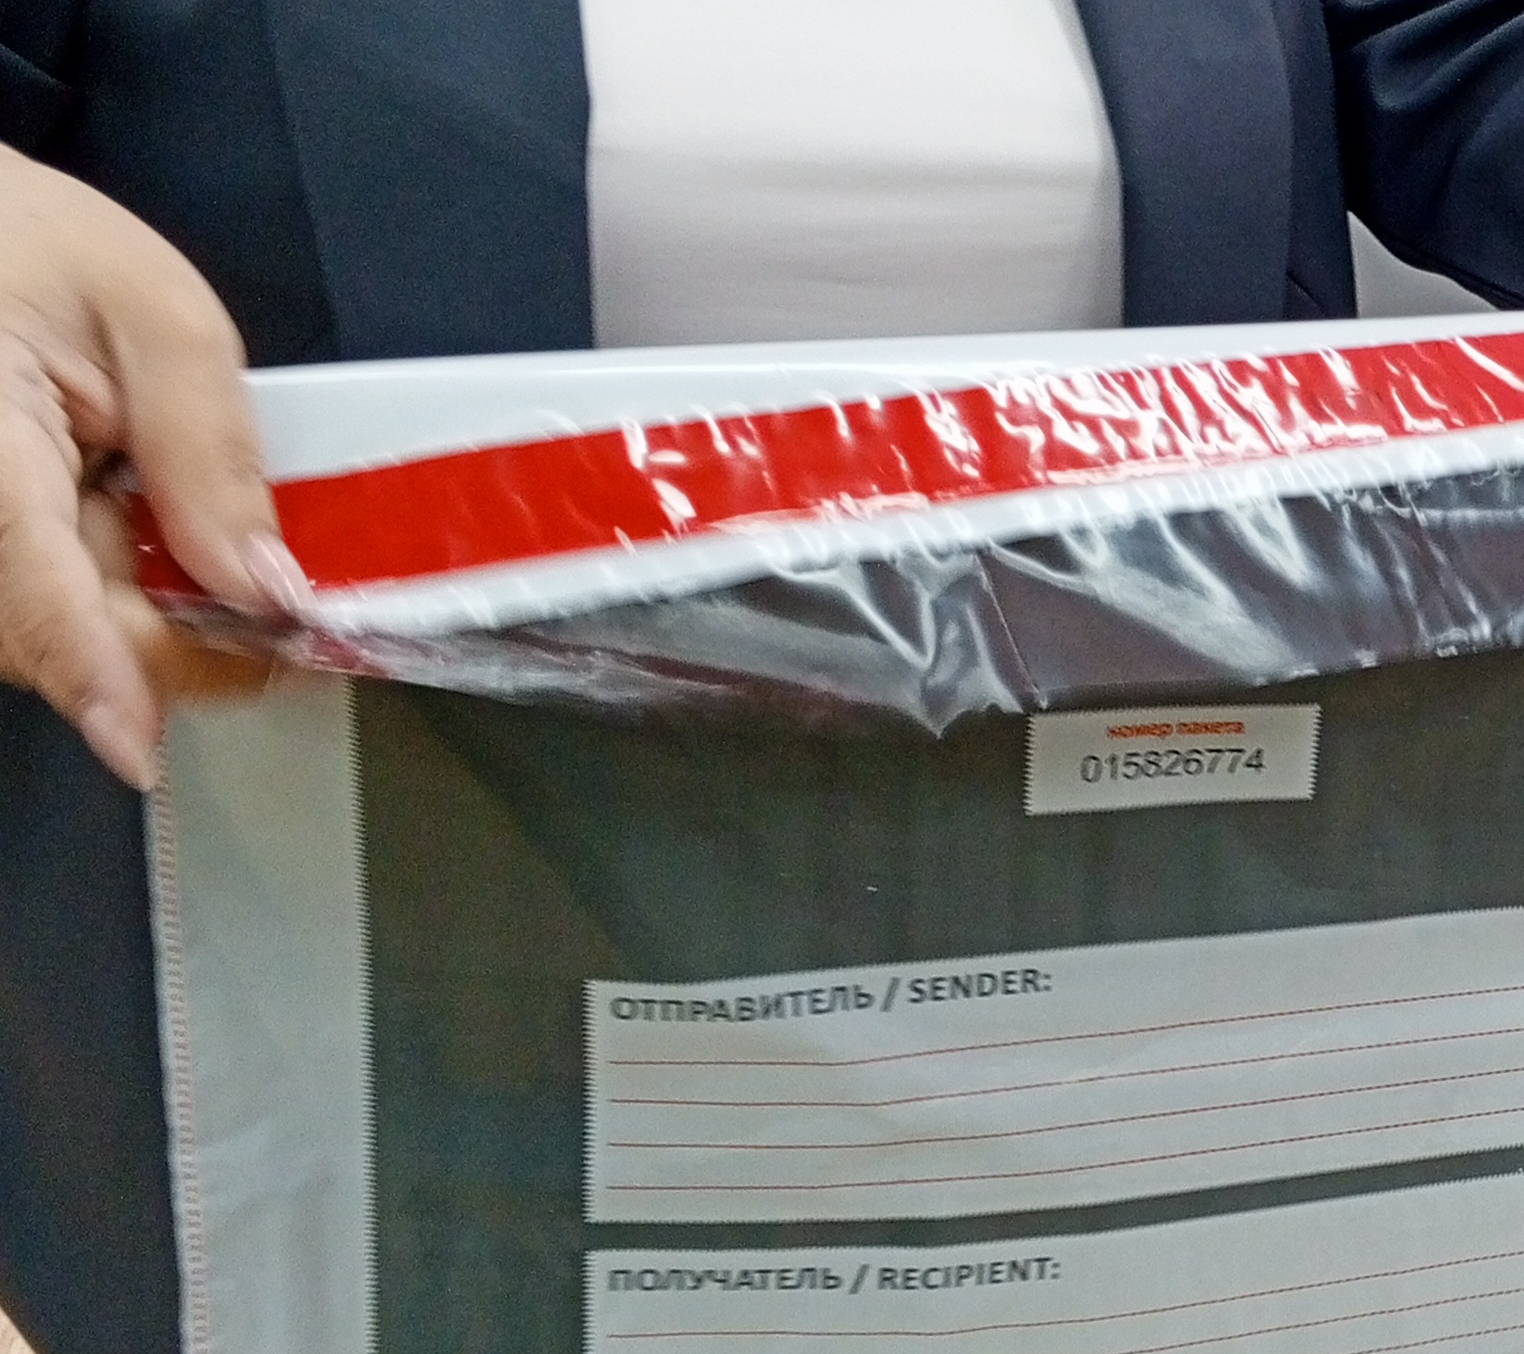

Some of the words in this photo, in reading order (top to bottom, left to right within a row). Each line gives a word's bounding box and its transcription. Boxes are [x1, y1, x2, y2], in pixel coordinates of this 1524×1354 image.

[1079, 746, 1267, 783] 015826774
[608, 983, 876, 1023] ОТПРАВИТЕЛЬ
[907, 967, 1054, 1005] SENDER:
[607, 1265, 842, 1293] ПОЛУЧАТЕЛЬ
[877, 1255, 1062, 1292] RECIPIENT:
